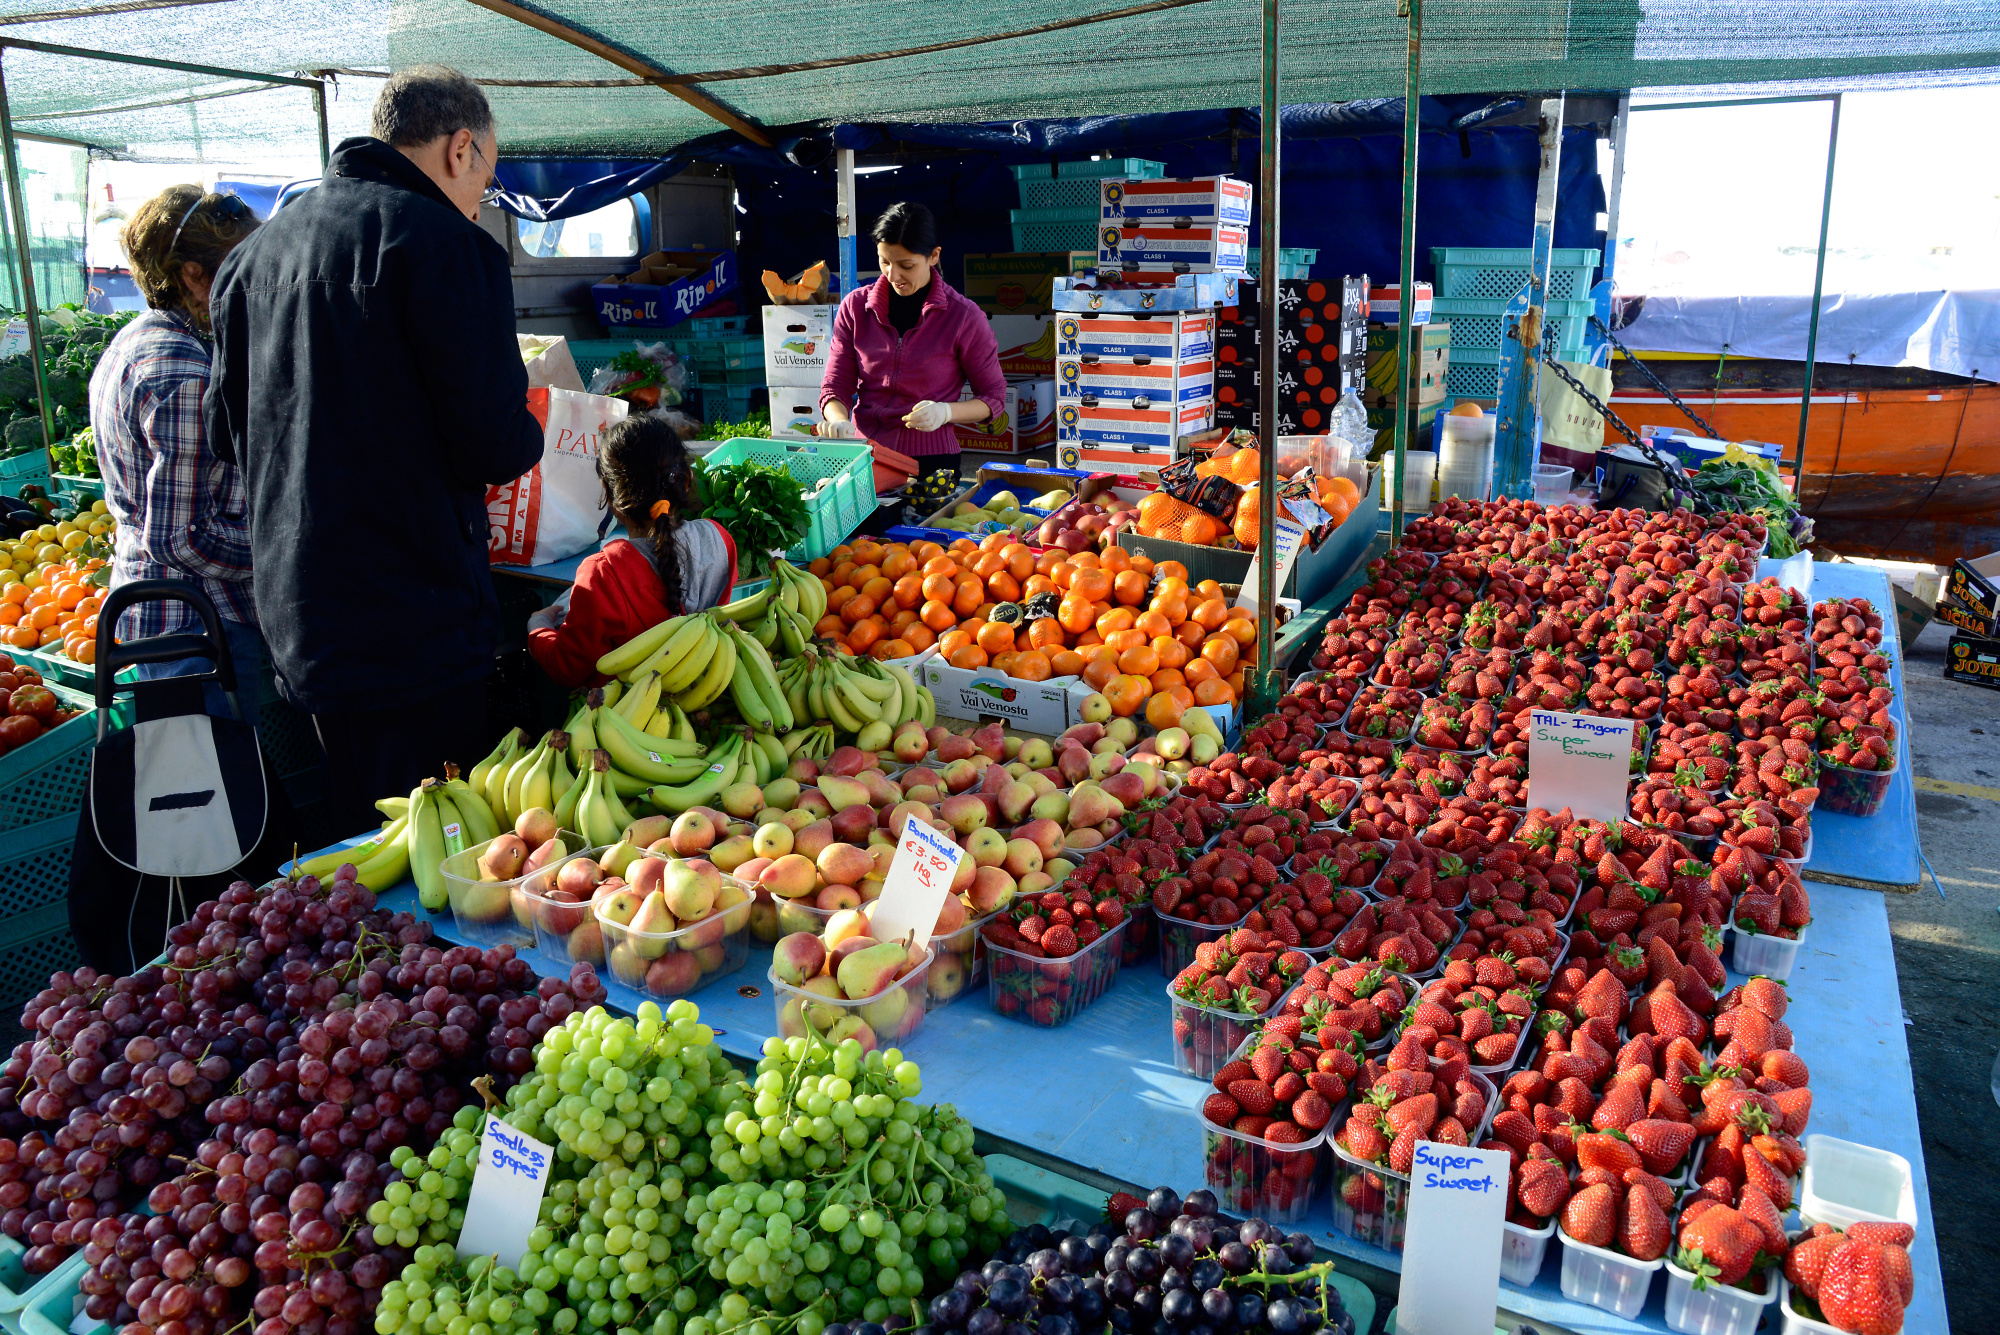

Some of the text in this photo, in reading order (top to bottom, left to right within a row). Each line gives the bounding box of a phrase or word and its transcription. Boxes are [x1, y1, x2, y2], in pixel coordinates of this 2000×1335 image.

[1177, 193, 1213, 204] GRAPES
[601, 301, 658, 323] Ripoll
[1133, 334, 1170, 344] GRAPES
[774, 355, 824, 366] Val Venosta
[1015, 362, 1051, 371] BANANAS
[1018, 396, 1037, 415] Dole
[1133, 423, 1168, 433] GRAPES
[967, 438, 1009, 450] BANANAS
[554, 449, 584, 459] SHOPPING
[1940, 607, 1985, 635] SICILIA
[961, 693, 979, 708] Val
[981, 697, 1028, 716] Venosta
[1537, 728, 1590, 749] Super
[1564, 745, 1615, 760] Sweet
[487, 1120, 545, 1168] Seedless
[491, 1149, 539, 1181] grapes
[1414, 1145, 1484, 1175] Super
